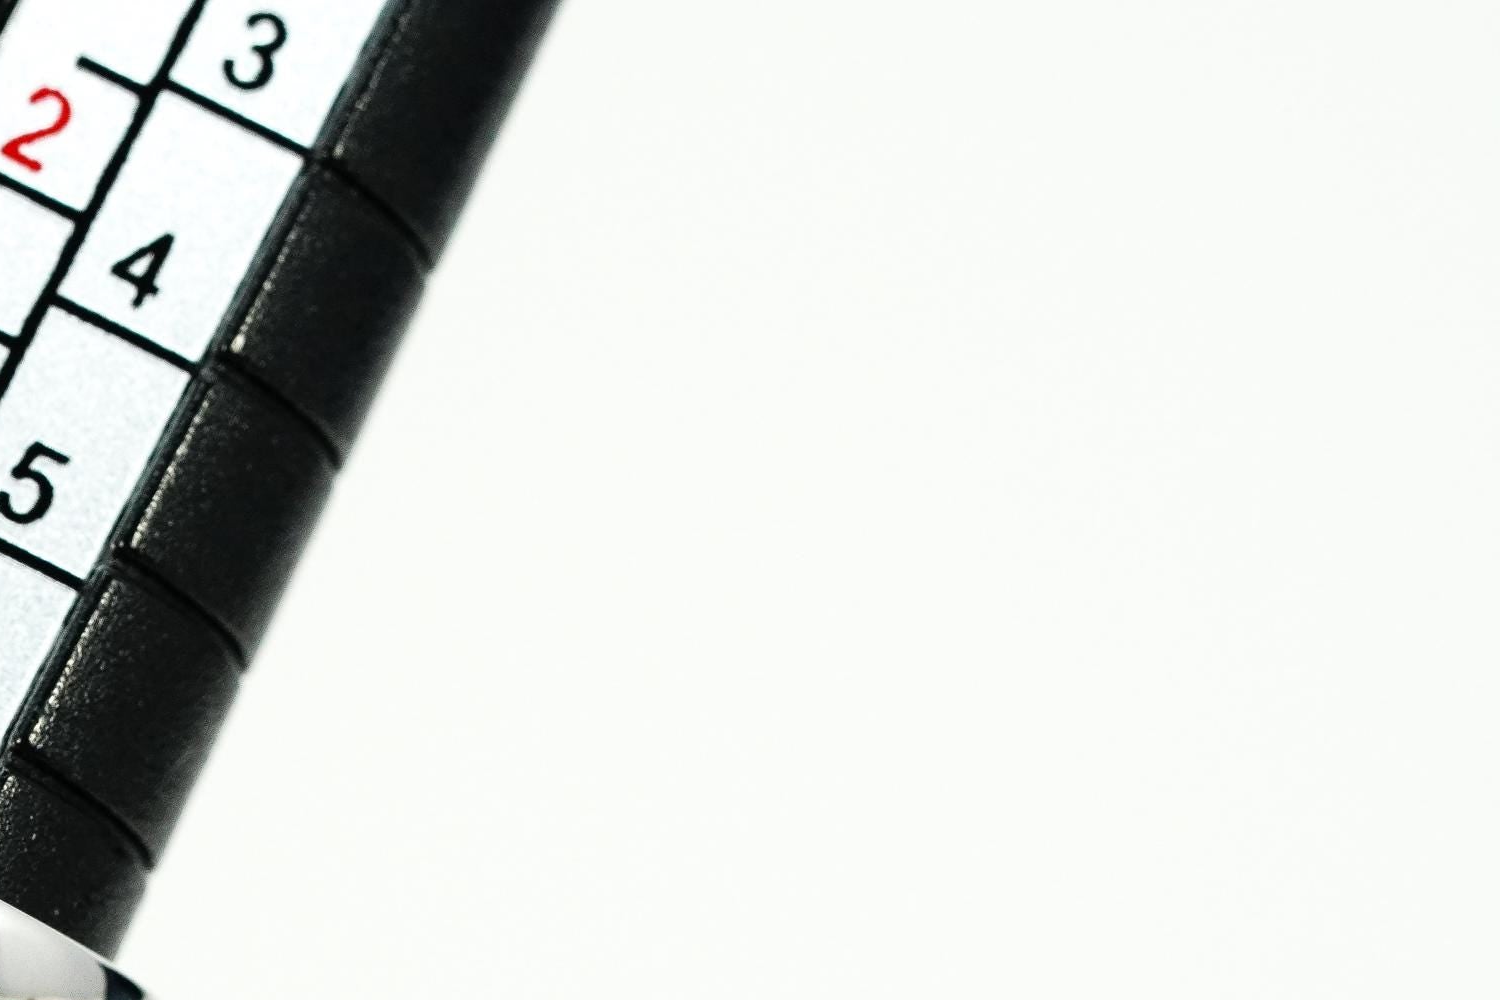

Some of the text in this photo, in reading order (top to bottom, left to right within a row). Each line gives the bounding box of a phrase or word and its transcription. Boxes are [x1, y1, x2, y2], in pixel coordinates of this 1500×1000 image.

[223, 12, 287, 91] 3
[0, 86, 73, 173] 2
[111, 232, 175, 308] 4
